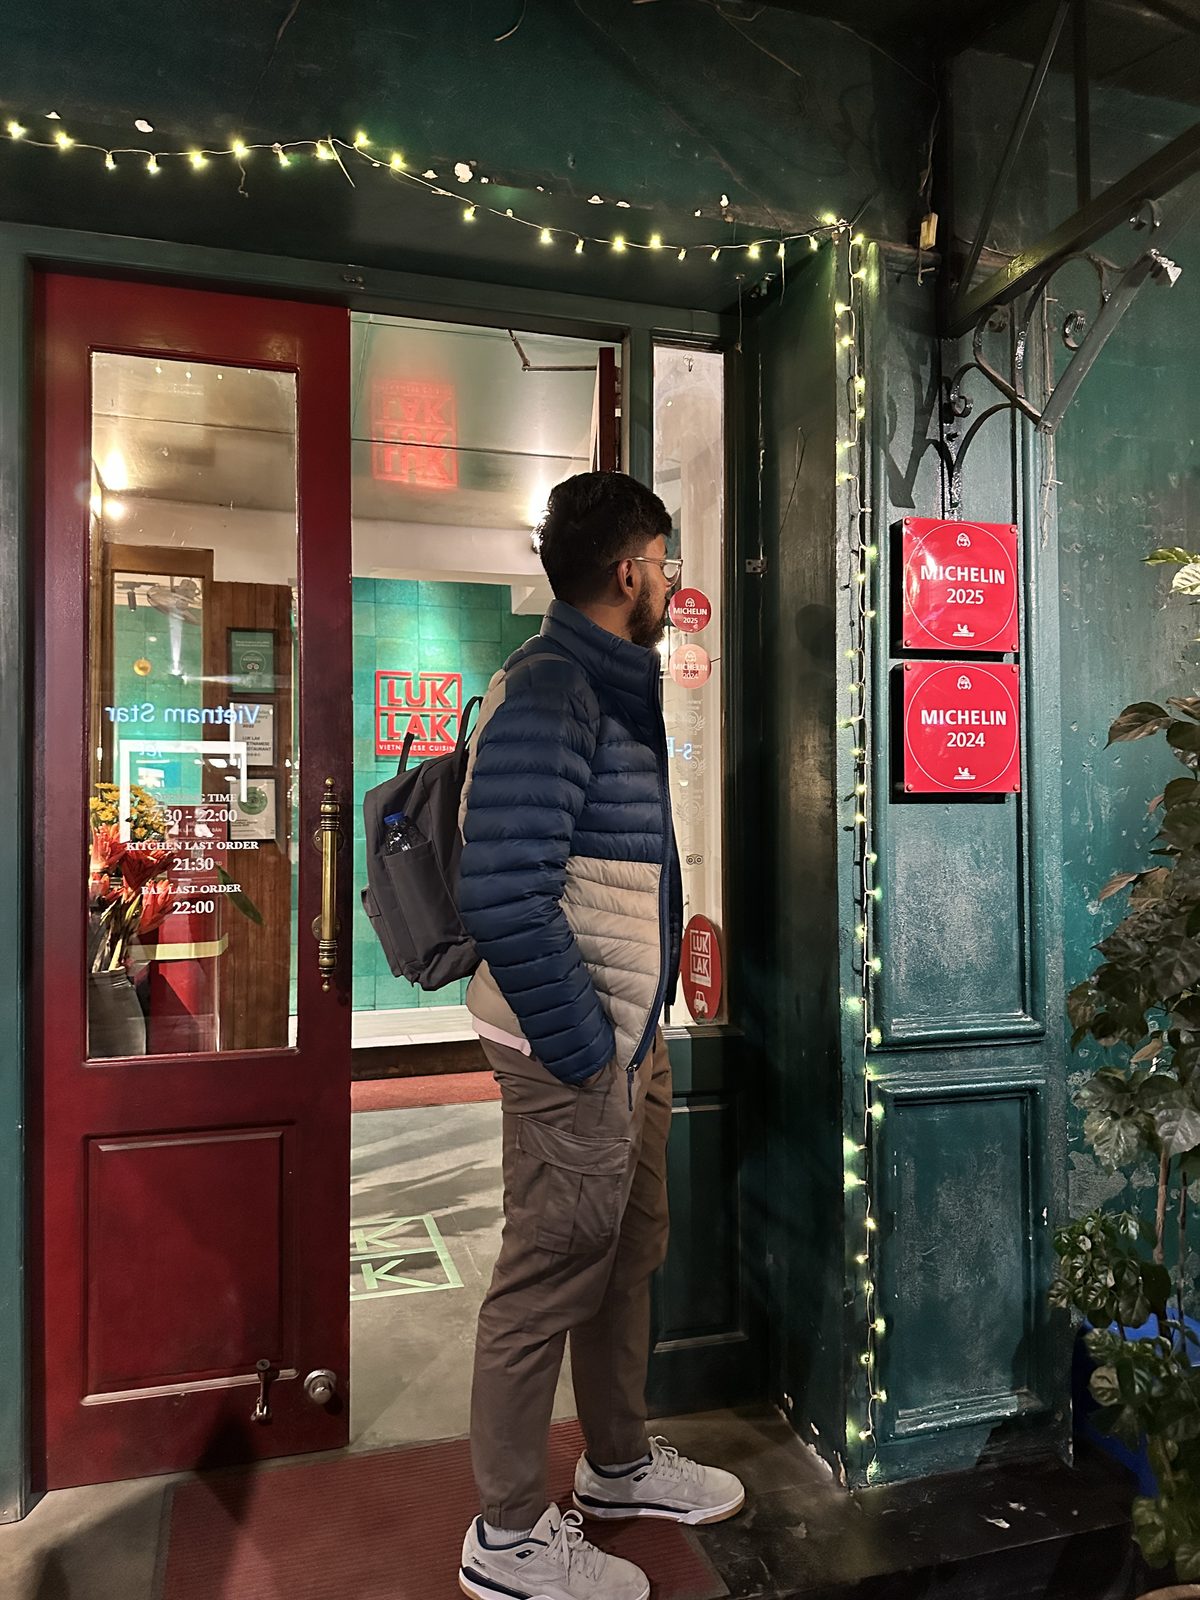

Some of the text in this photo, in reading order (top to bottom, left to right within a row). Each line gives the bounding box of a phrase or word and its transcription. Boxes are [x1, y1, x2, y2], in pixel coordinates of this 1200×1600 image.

[920, 565, 1005, 585] MICHELIN
[946, 588, 984, 605] 2025
[673, 607, 708, 616] MICHELIN
[673, 663, 708, 672] MICHELIN
[388, 677, 453, 707] LUK
[920, 709, 1007, 726] MICHELIN
[388, 712, 454, 740] LAK
[946, 732, 986, 748] 2024
[379, 744, 426, 752] VIETNESE
[206, 793, 238, 802] TIME
[196, 808, 238, 822] 22:00
[126, 841, 259, 851] KITCHEN LAST ORDER
[172, 857, 215, 871] 21:30
[168, 885, 198, 894] LAST
[200, 884, 242, 894] ORDER
[172, 900, 215, 914] 22:00
[692, 934, 709, 954] LUK
[692, 955, 710, 978] LAK
